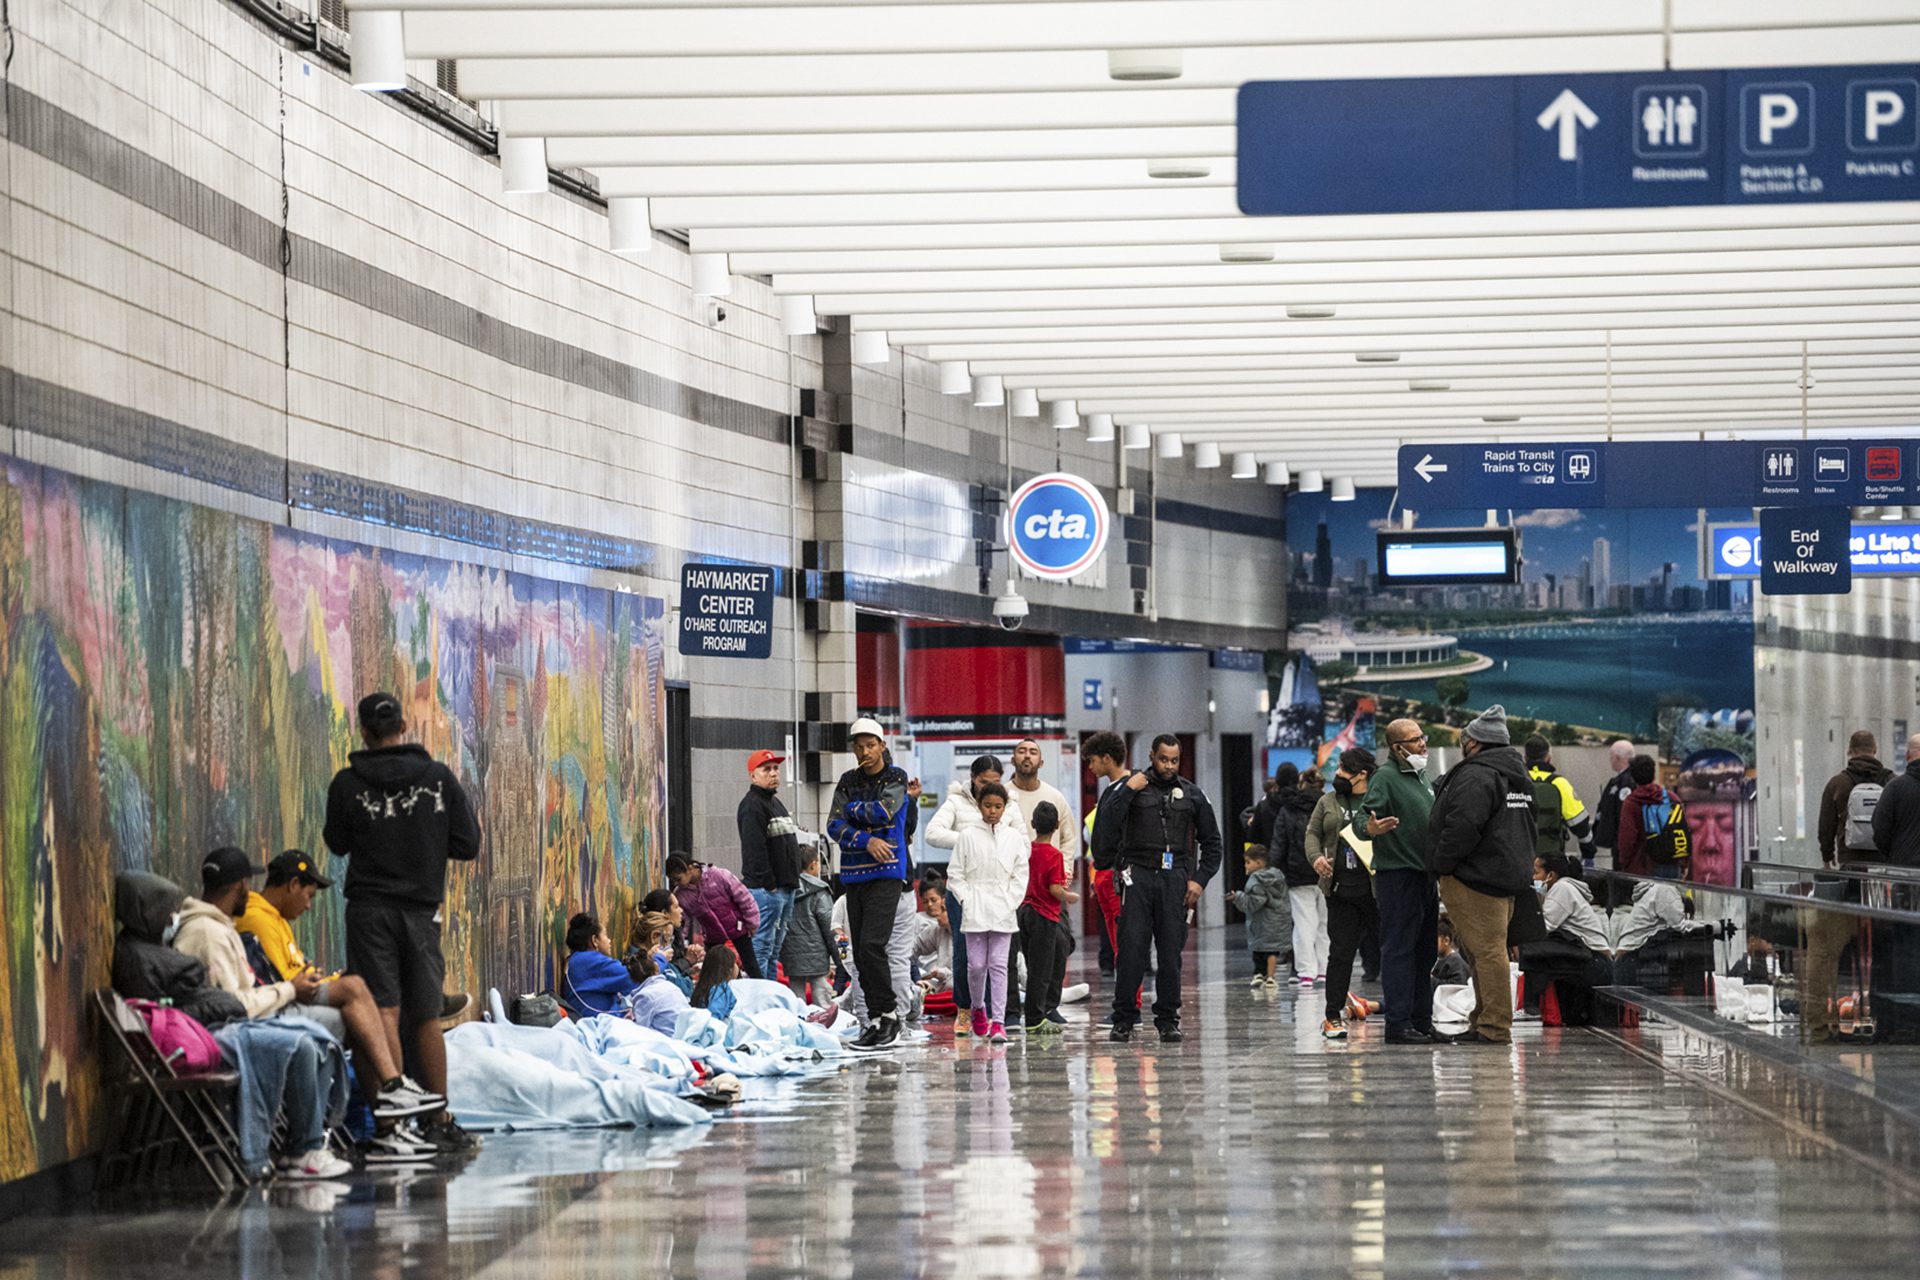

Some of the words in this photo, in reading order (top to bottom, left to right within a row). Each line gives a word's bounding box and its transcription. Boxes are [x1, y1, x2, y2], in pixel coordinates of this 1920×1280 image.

[1759, 93, 1799, 145] P
[1865, 89, 1905, 142] P
[1632, 166, 1708, 180] Restrooms
[1740, 164, 1795, 180] Parking
[1796, 163, 1808, 178] A
[1846, 161, 1900, 176] Parking
[1484, 450, 1516, 461] Rapid
[1518, 450, 1555, 460] Transit
[1482, 462, 1515, 473] Trains
[1517, 462, 1531, 473] To
[1533, 461, 1555, 474] City
[1535, 474, 1555, 484] cta
[1865, 485, 1905, 493] Bus/Shuttle
[1865, 492, 1889, 500] Center
[1024, 509, 1087, 540] cta
[1791, 529, 1820, 543] End
[1868, 533, 1910, 551] Line
[1796, 544, 1815, 558] Of
[1773, 560, 1838, 575] Walkway
[686, 569, 769, 592] HAYMARKET
[700, 594, 754, 615] CENTER
[684, 616, 717, 632] O'HARE
[719, 618, 767, 634] OUTREACH
[702, 635, 747, 652] PROGRAM
